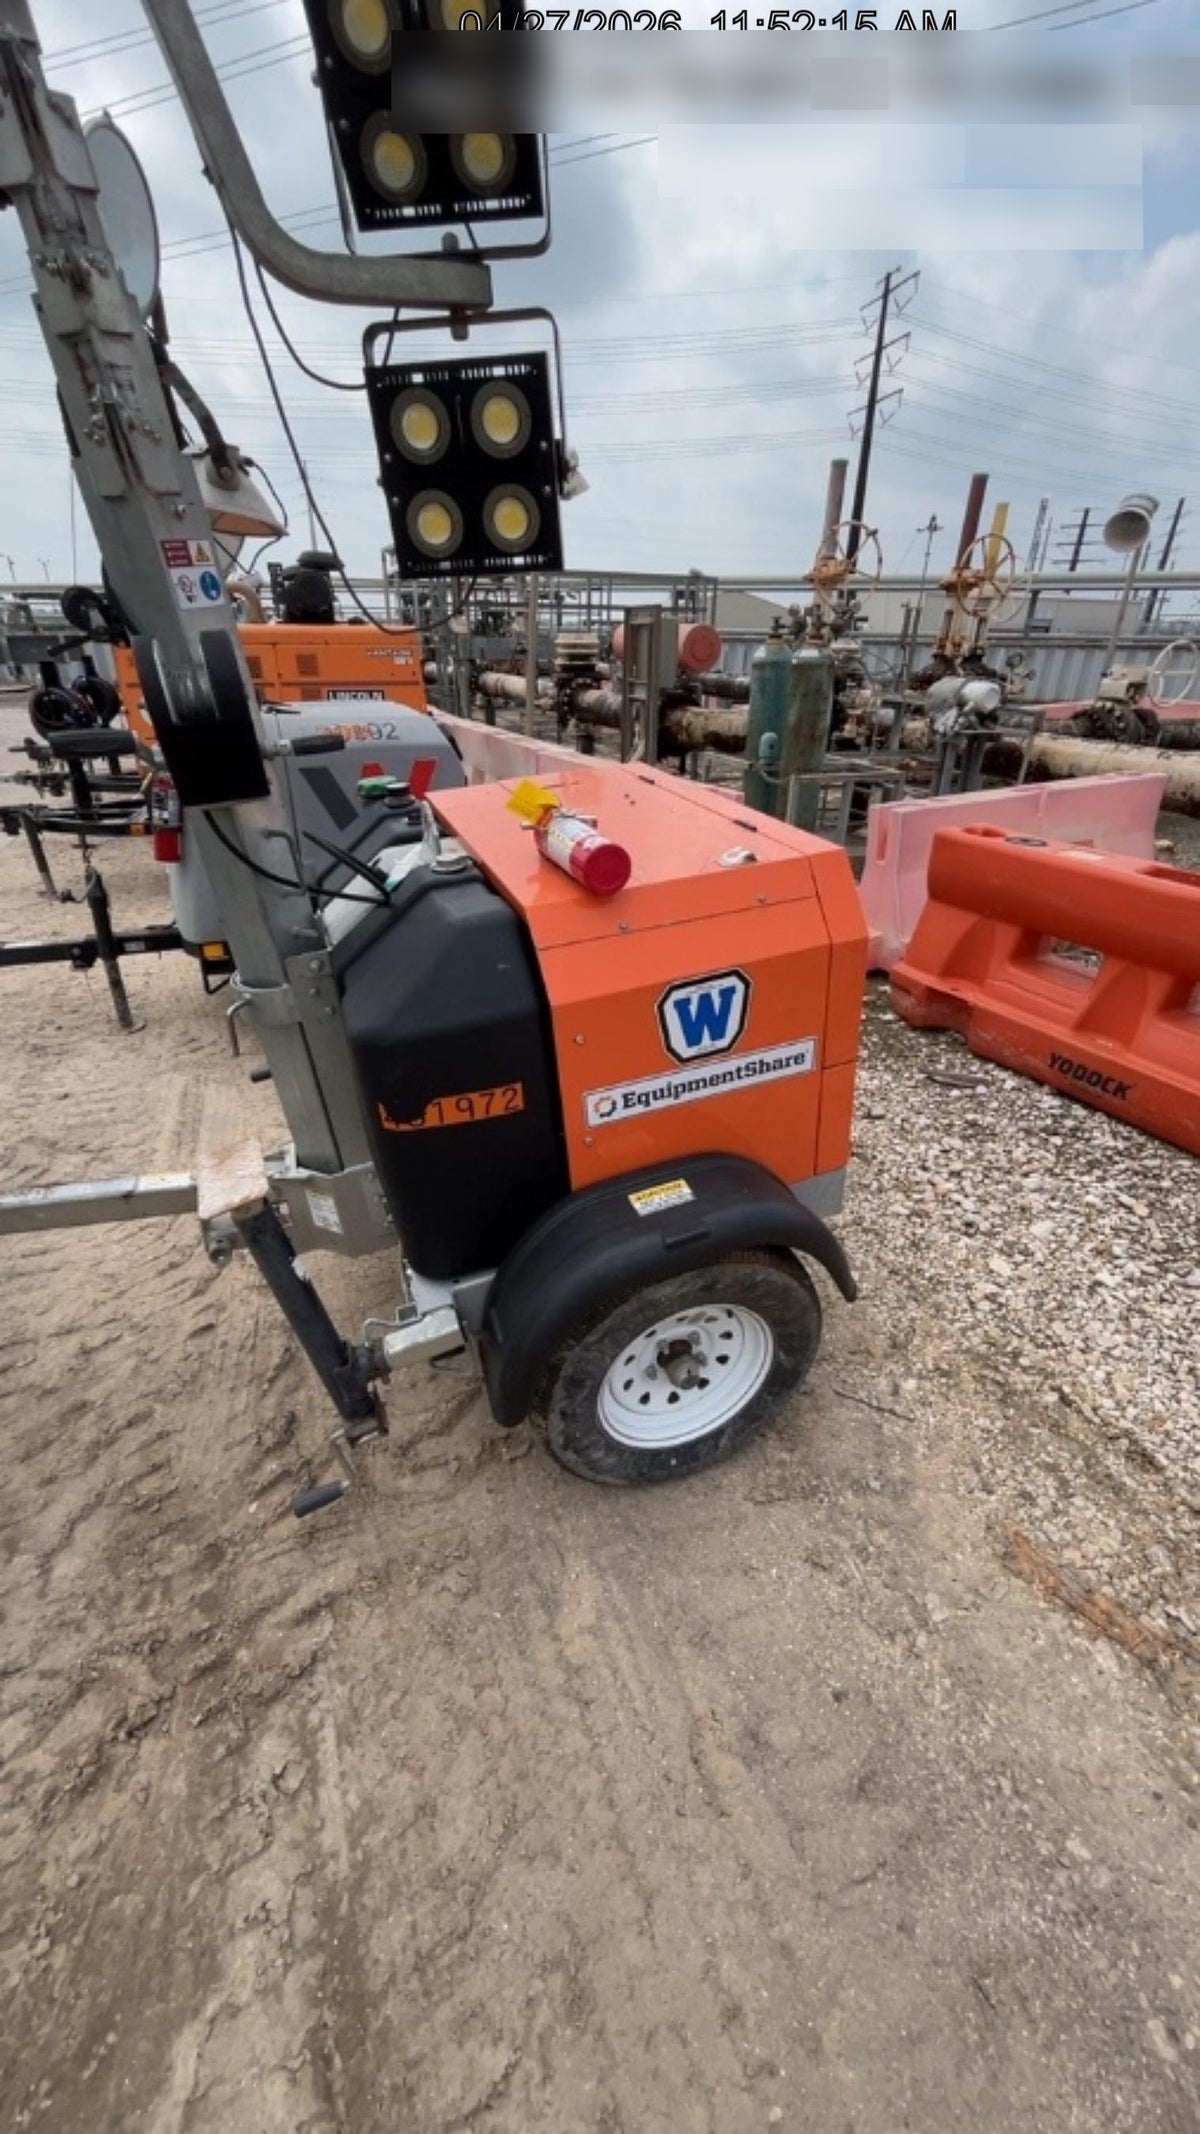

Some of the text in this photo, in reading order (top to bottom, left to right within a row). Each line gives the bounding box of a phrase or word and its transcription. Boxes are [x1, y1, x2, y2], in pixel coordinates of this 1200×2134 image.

[673, 985, 736, 1048] W
[622, 1051, 806, 1109] EquipmentShare
[1048, 1052, 1132, 1101] YODOCK
[384, 1086, 518, 1127] 1972
